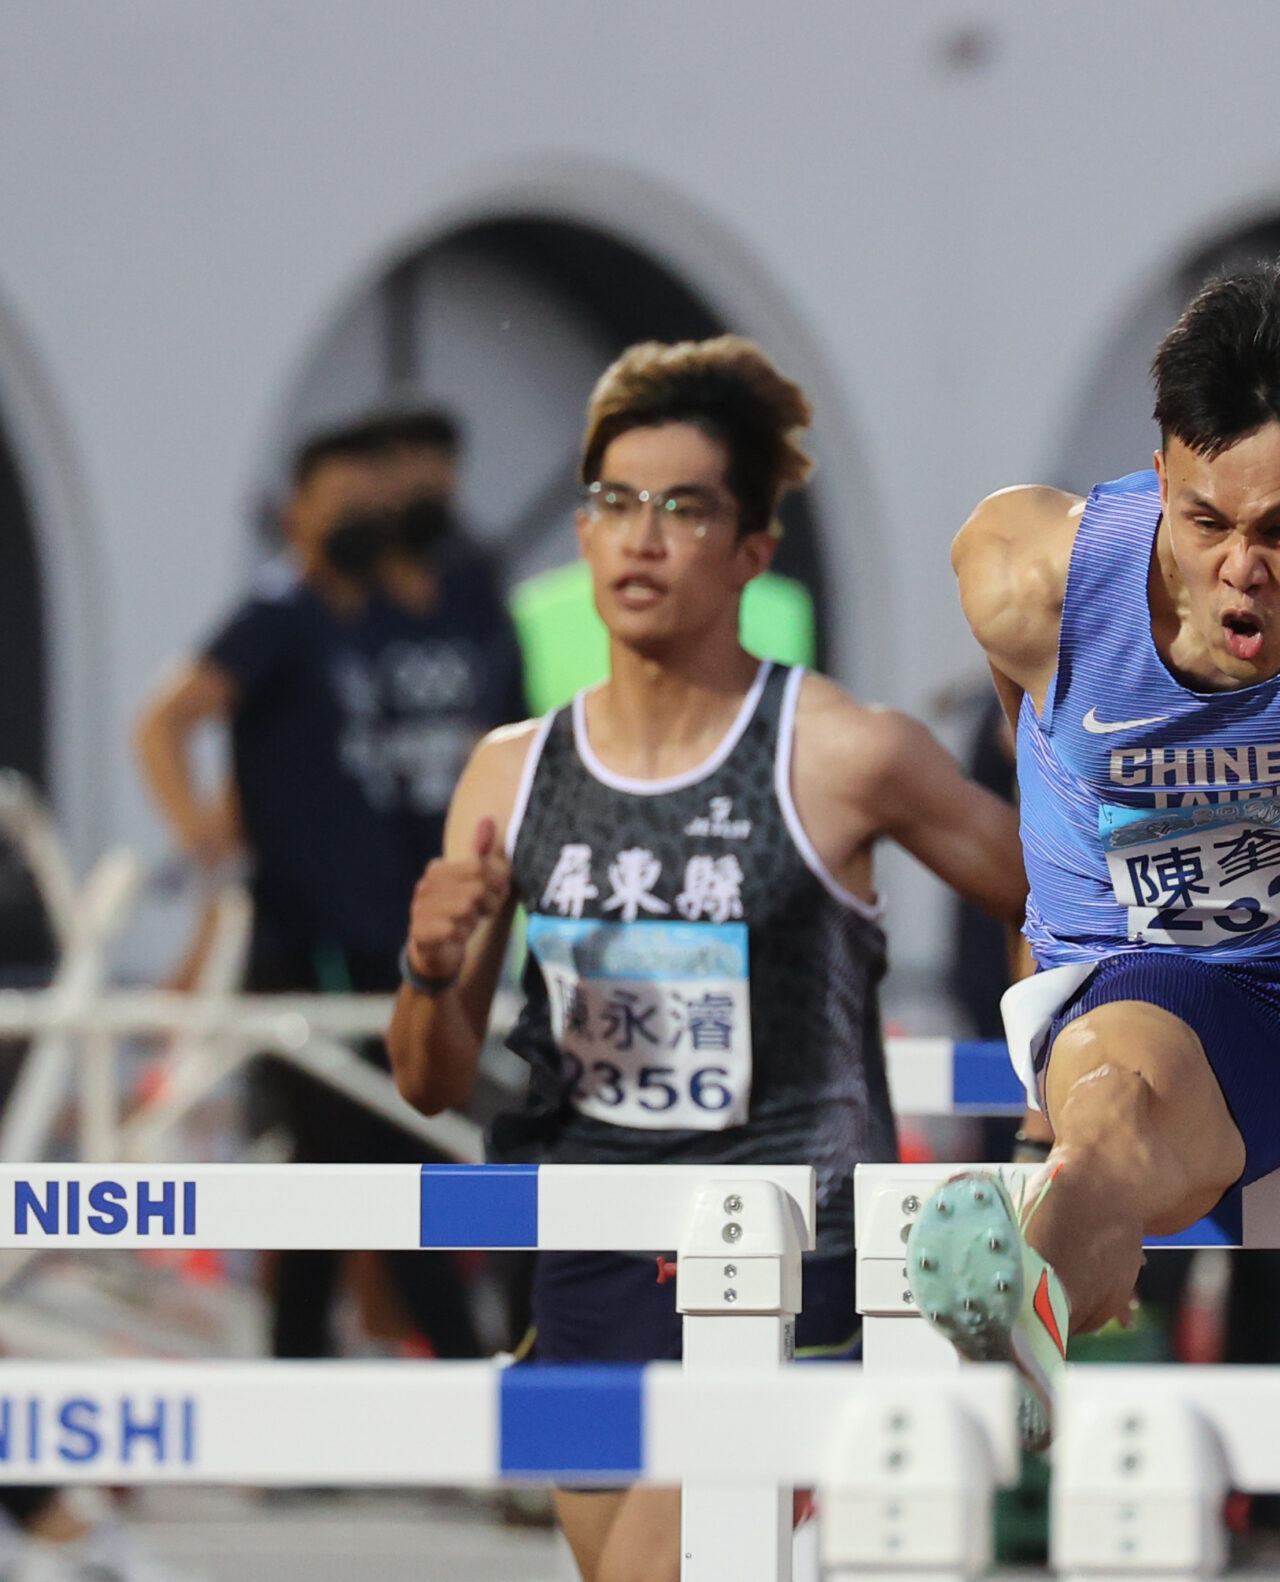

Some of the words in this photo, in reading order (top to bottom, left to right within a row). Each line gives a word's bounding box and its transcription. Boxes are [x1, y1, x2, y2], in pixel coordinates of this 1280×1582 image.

[540, 843, 746, 922] 屏東縣
[14, 1180, 197, 1236] NISHI
[0, 1395, 197, 1465] ISHI
